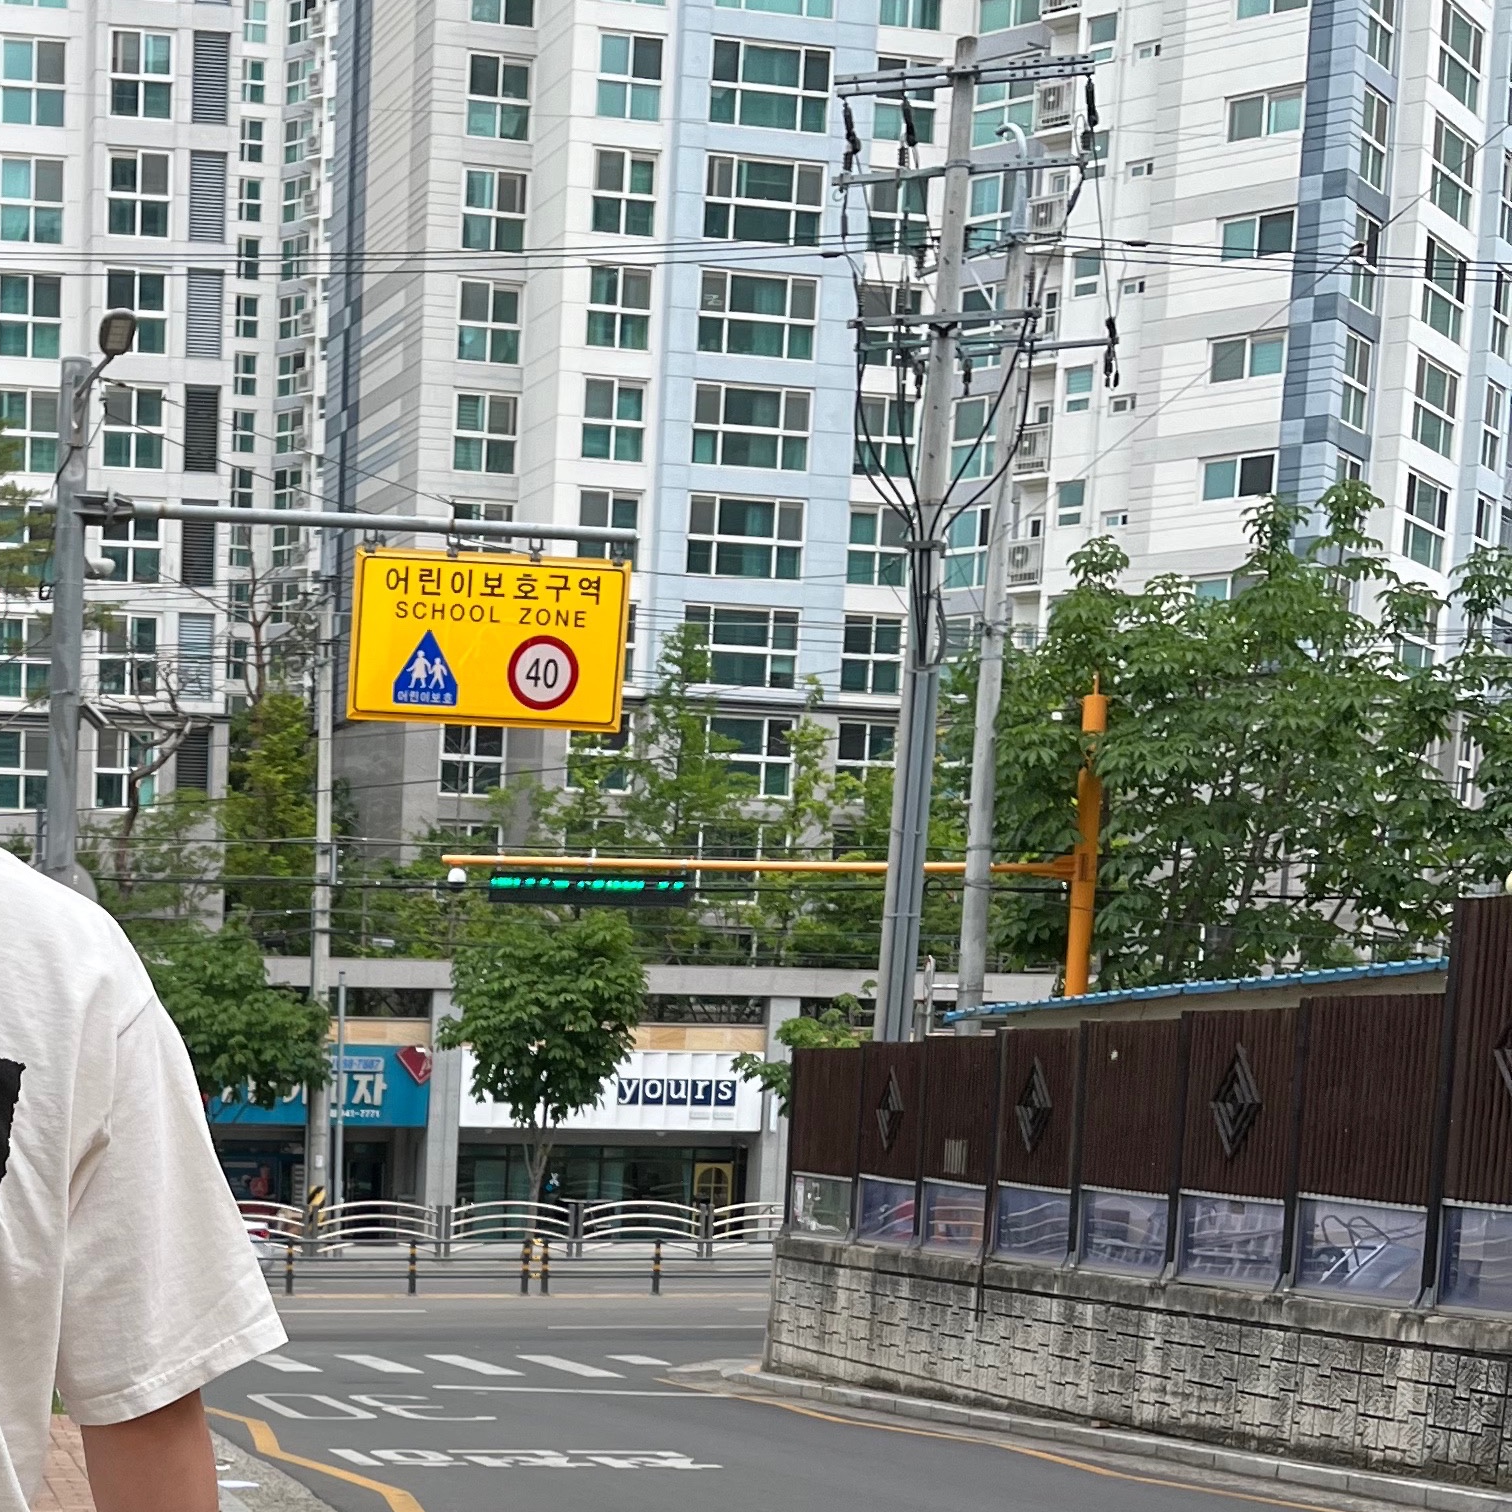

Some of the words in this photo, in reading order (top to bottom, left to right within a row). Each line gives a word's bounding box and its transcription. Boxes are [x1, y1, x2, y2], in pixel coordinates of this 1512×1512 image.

[386, 566, 601, 605] 어린이보호구역
[395, 601, 500, 623] SCHOOL
[519, 608, 587, 628] ZONE
[526, 658, 559, 689] 40
[397, 690, 454, 704] 어린이보호
[619, 1078, 732, 1104] yours
